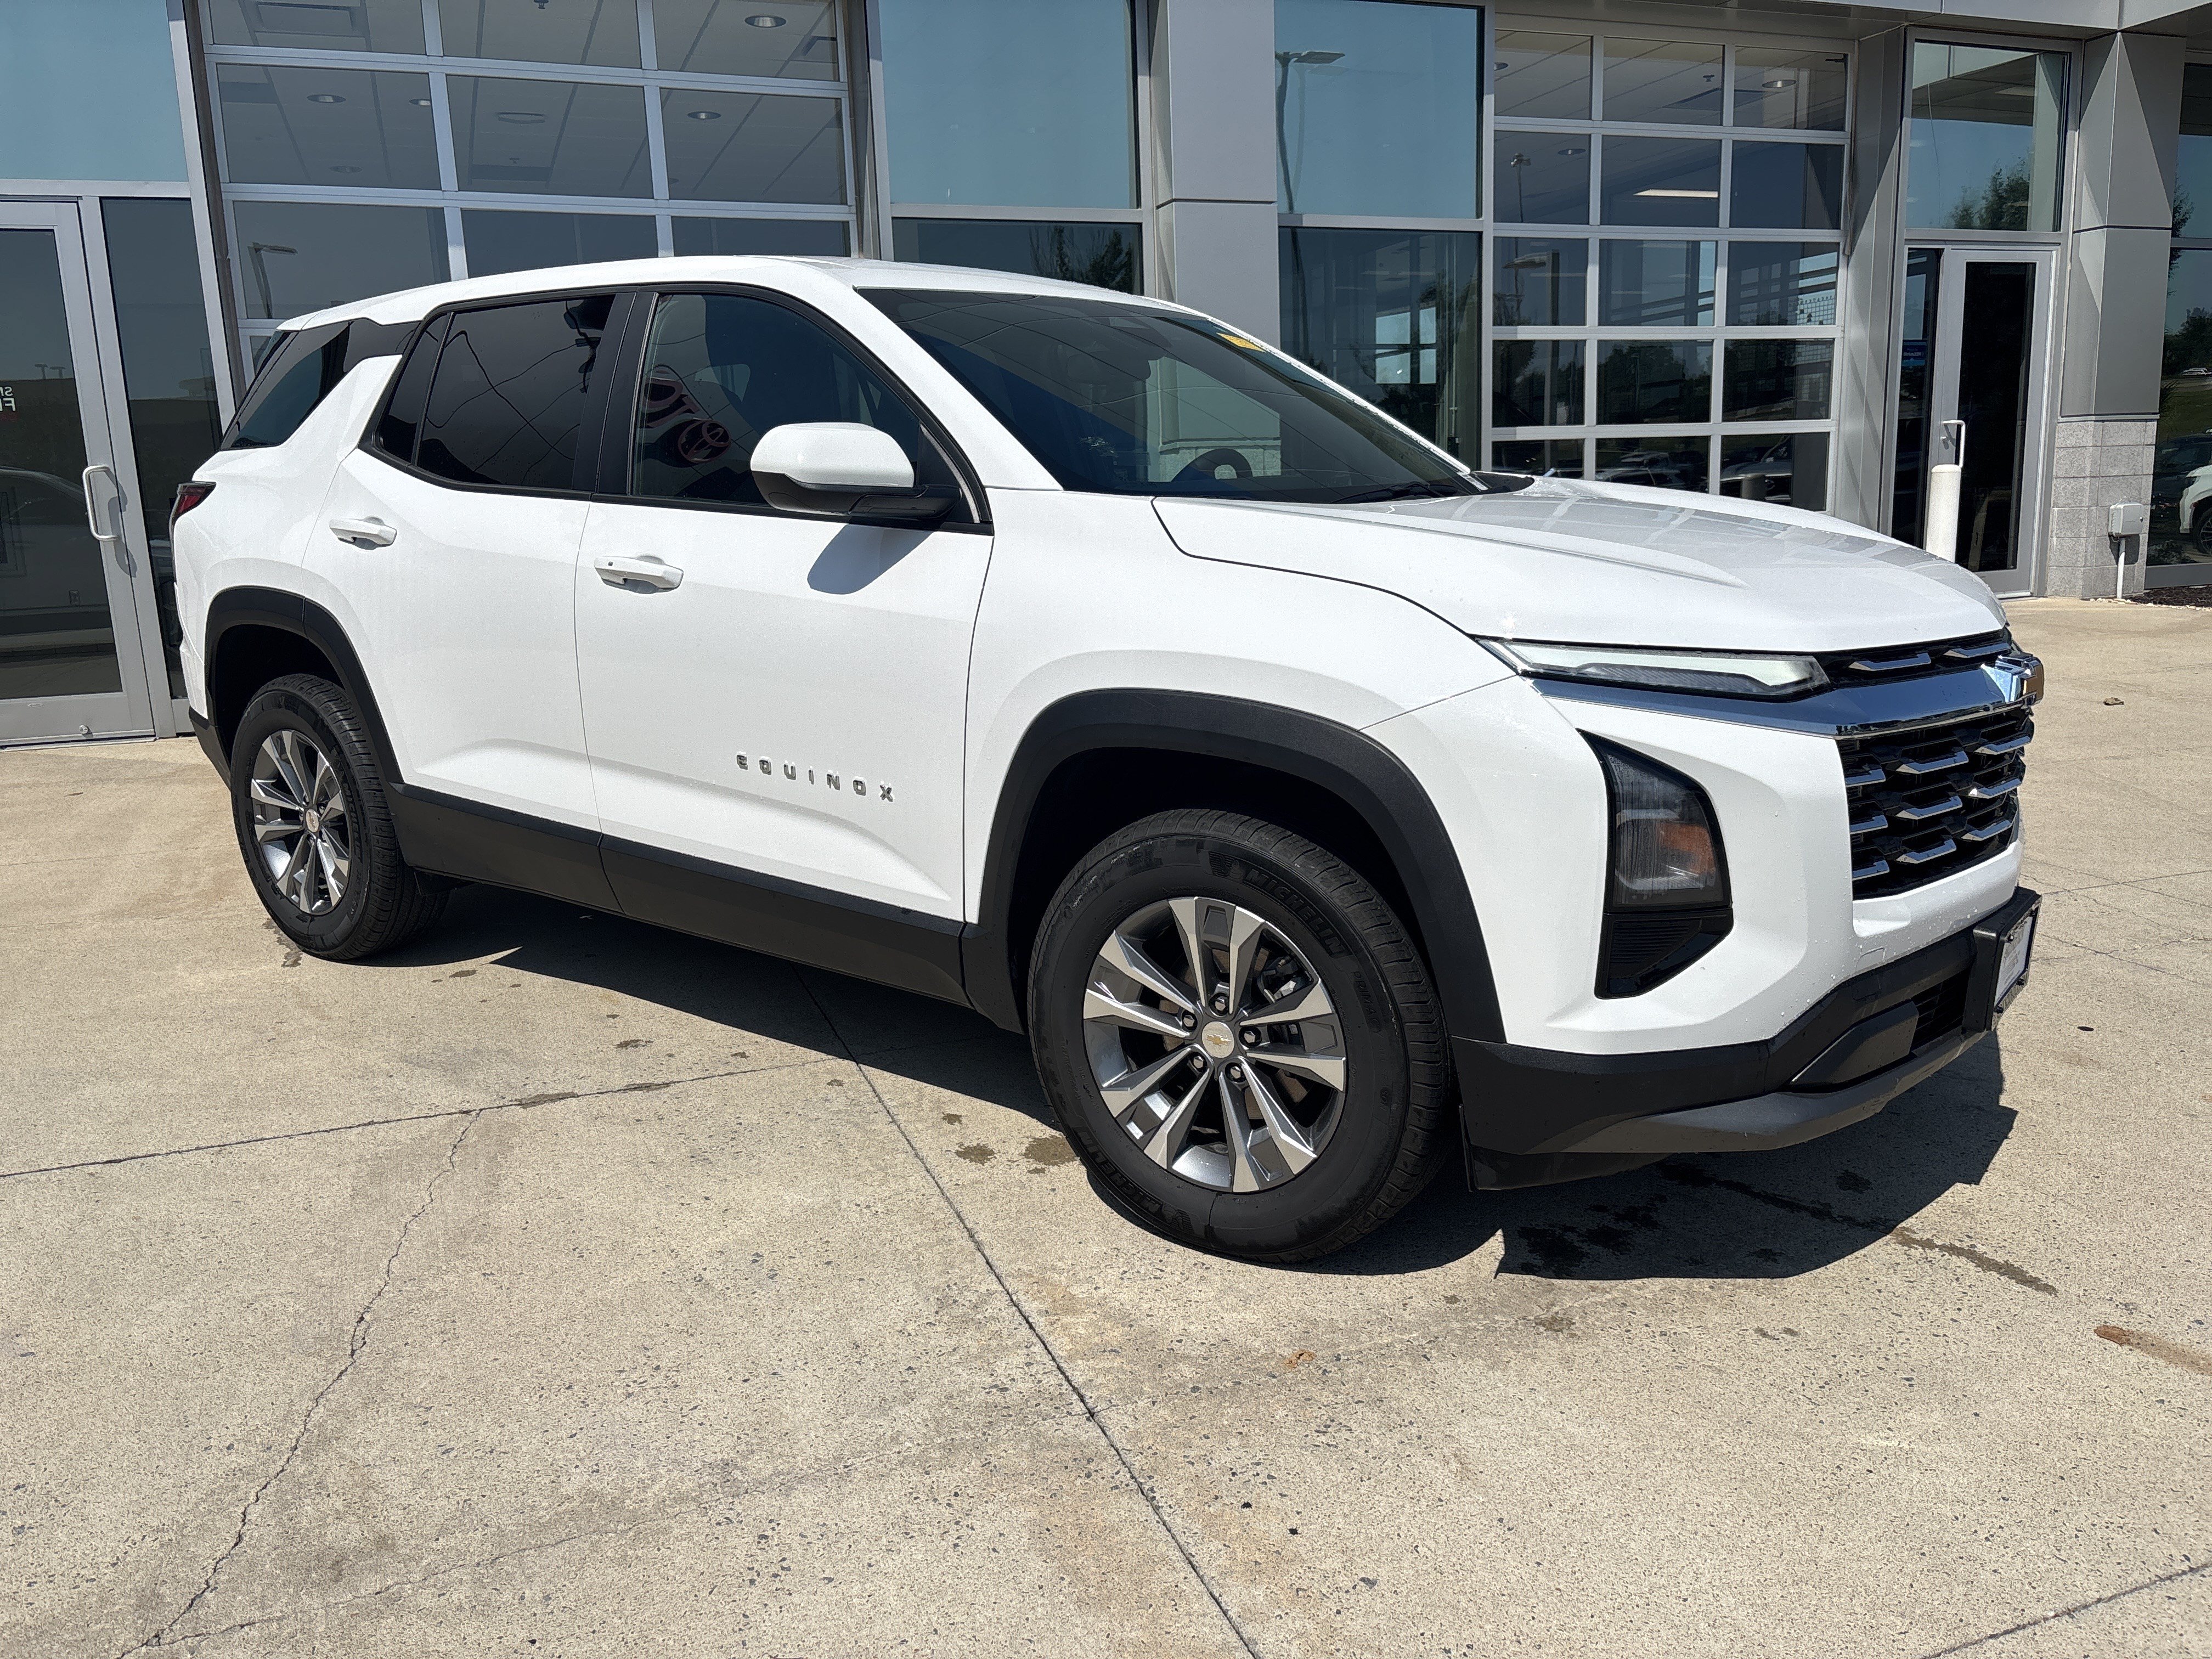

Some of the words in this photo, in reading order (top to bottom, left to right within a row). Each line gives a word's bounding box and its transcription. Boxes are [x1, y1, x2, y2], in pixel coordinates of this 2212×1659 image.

[736, 751, 895, 803] EQUINOX
[1244, 868, 1347, 956] MICHELIN
[1353, 971, 1383, 1036] PRIMACY
[1076, 1128, 1161, 1214] MICHELIN
